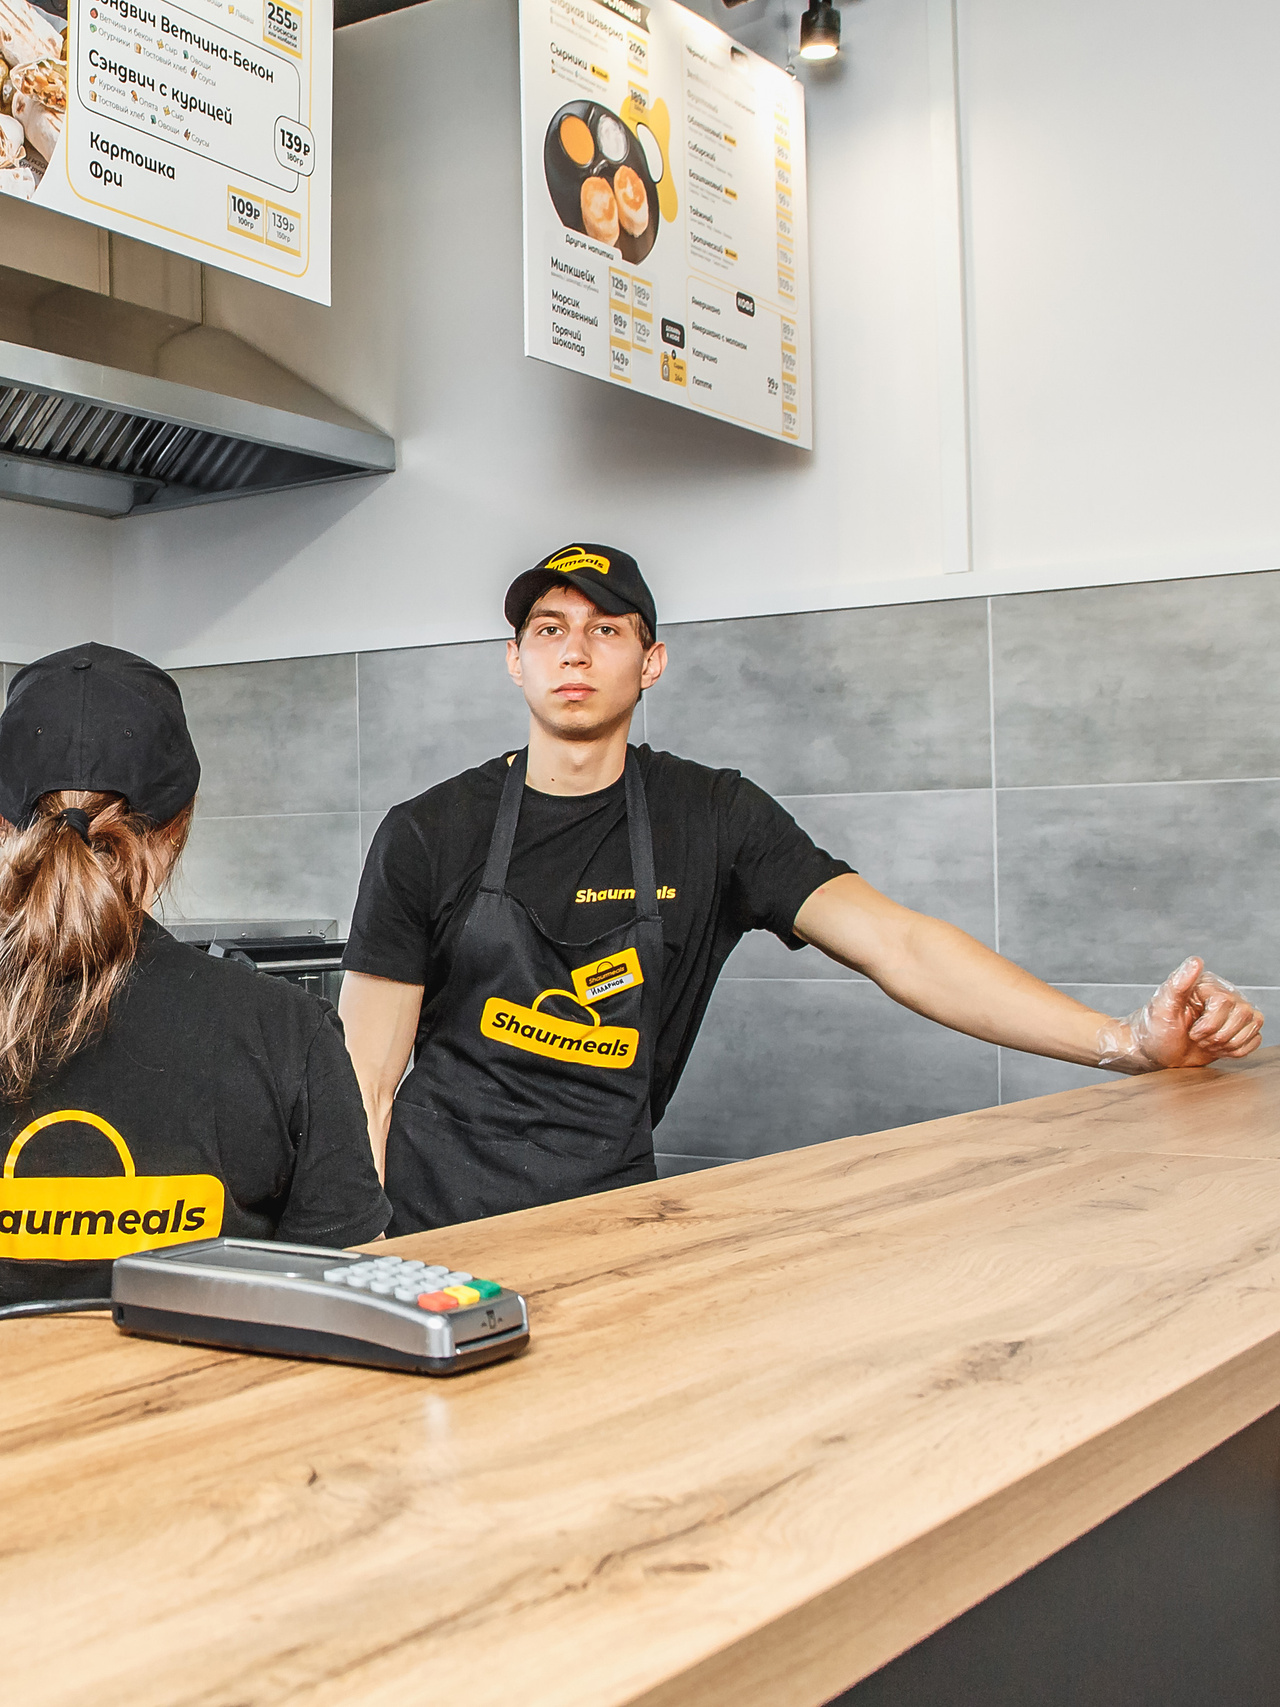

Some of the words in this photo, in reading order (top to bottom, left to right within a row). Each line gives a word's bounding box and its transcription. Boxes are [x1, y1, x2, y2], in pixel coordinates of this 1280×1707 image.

[100, 13, 127, 32] Ветчина
[134, 28, 153, 43] бекон
[165, 43, 178, 56] Сыр
[190, 55, 211, 70] Овощи
[161, 15, 274, 83] Ветчина-Бекон
[98, 27, 131, 48] Огурчики
[143, 48, 172, 67] Тостовый
[173, 62, 187, 74] хлеб
[198, 73, 216, 87] Соусы
[550, 42, 587, 70] Сырники
[89, 49, 155, 92] Сэндвич
[159, 83, 167, 96] с
[171, 87, 233, 125] курицей
[98, 78, 126, 97] Курочка
[139, 97, 159, 112] Опята
[171, 109, 184, 122] Сыр
[98, 95, 128, 115] Тостовый
[130, 110, 145, 121] хлеб
[158, 119, 180, 135] Овощи
[191, 133, 210, 148] Соусы
[90, 131, 176, 180] Картошка
[89, 160, 123, 187] Фри
[565, 233, 587, 250] Другие
[588, 244, 614, 261] напитки
[551, 256, 596, 284] Милкшейк
[551, 289, 580, 309] Морсик
[551, 302, 599, 327] клюквенный
[552, 322, 581, 341] Горячий
[552, 335, 585, 357] шоколад
[588, 966, 625, 985] Shaurmeals
[491, 1011, 629, 1057] Shaurmeals
